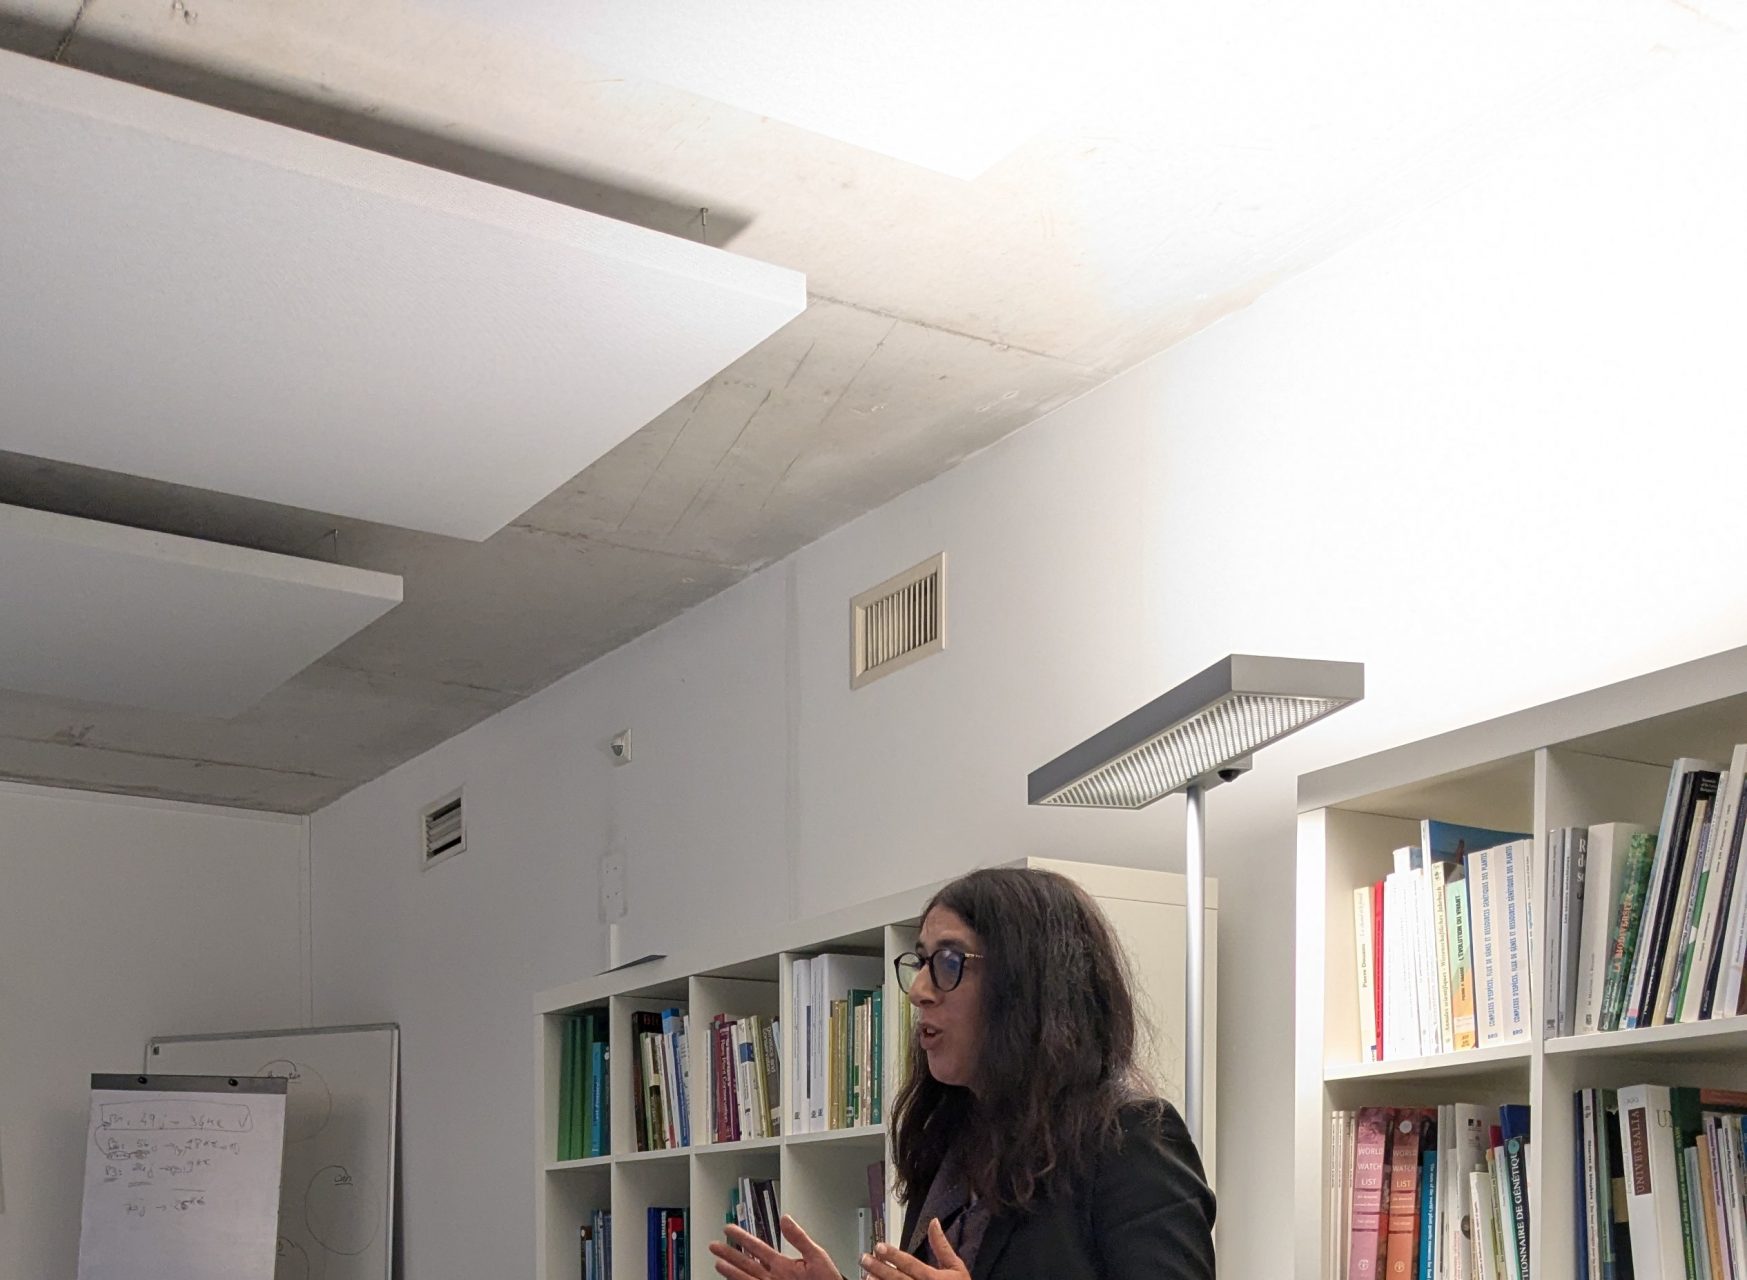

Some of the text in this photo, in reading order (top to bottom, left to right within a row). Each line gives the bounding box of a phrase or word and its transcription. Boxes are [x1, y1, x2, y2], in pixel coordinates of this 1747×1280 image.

[1480, 851, 1488, 871] PLANTES
[1504, 844, 1513, 864] PLANTES
[1481, 871, 1489, 880] DES
[1505, 864, 1513, 873] DES
[1453, 894, 1462, 914] VIVANT
[1455, 915, 1462, 924] DU
[1482, 908, 1491, 935] RESSOURCES
[1507, 902, 1516, 929] RESSOURCES
[1486, 1001, 1495, 1027] COMPLEXES
[1511, 997, 1520, 1023] COMPLEXES
[1358, 1147, 1383, 1156] WORLD
[1393, 1149, 1417, 1157] WORLD
[1631, 1110, 1646, 1194] UNIVERSALIA
[1358, 1162, 1382, 1171] WATCH
[1361, 1178, 1376, 1186] LIST
[1396, 1180, 1410, 1188] LIST
[1514, 1204, 1524, 1220] DE
